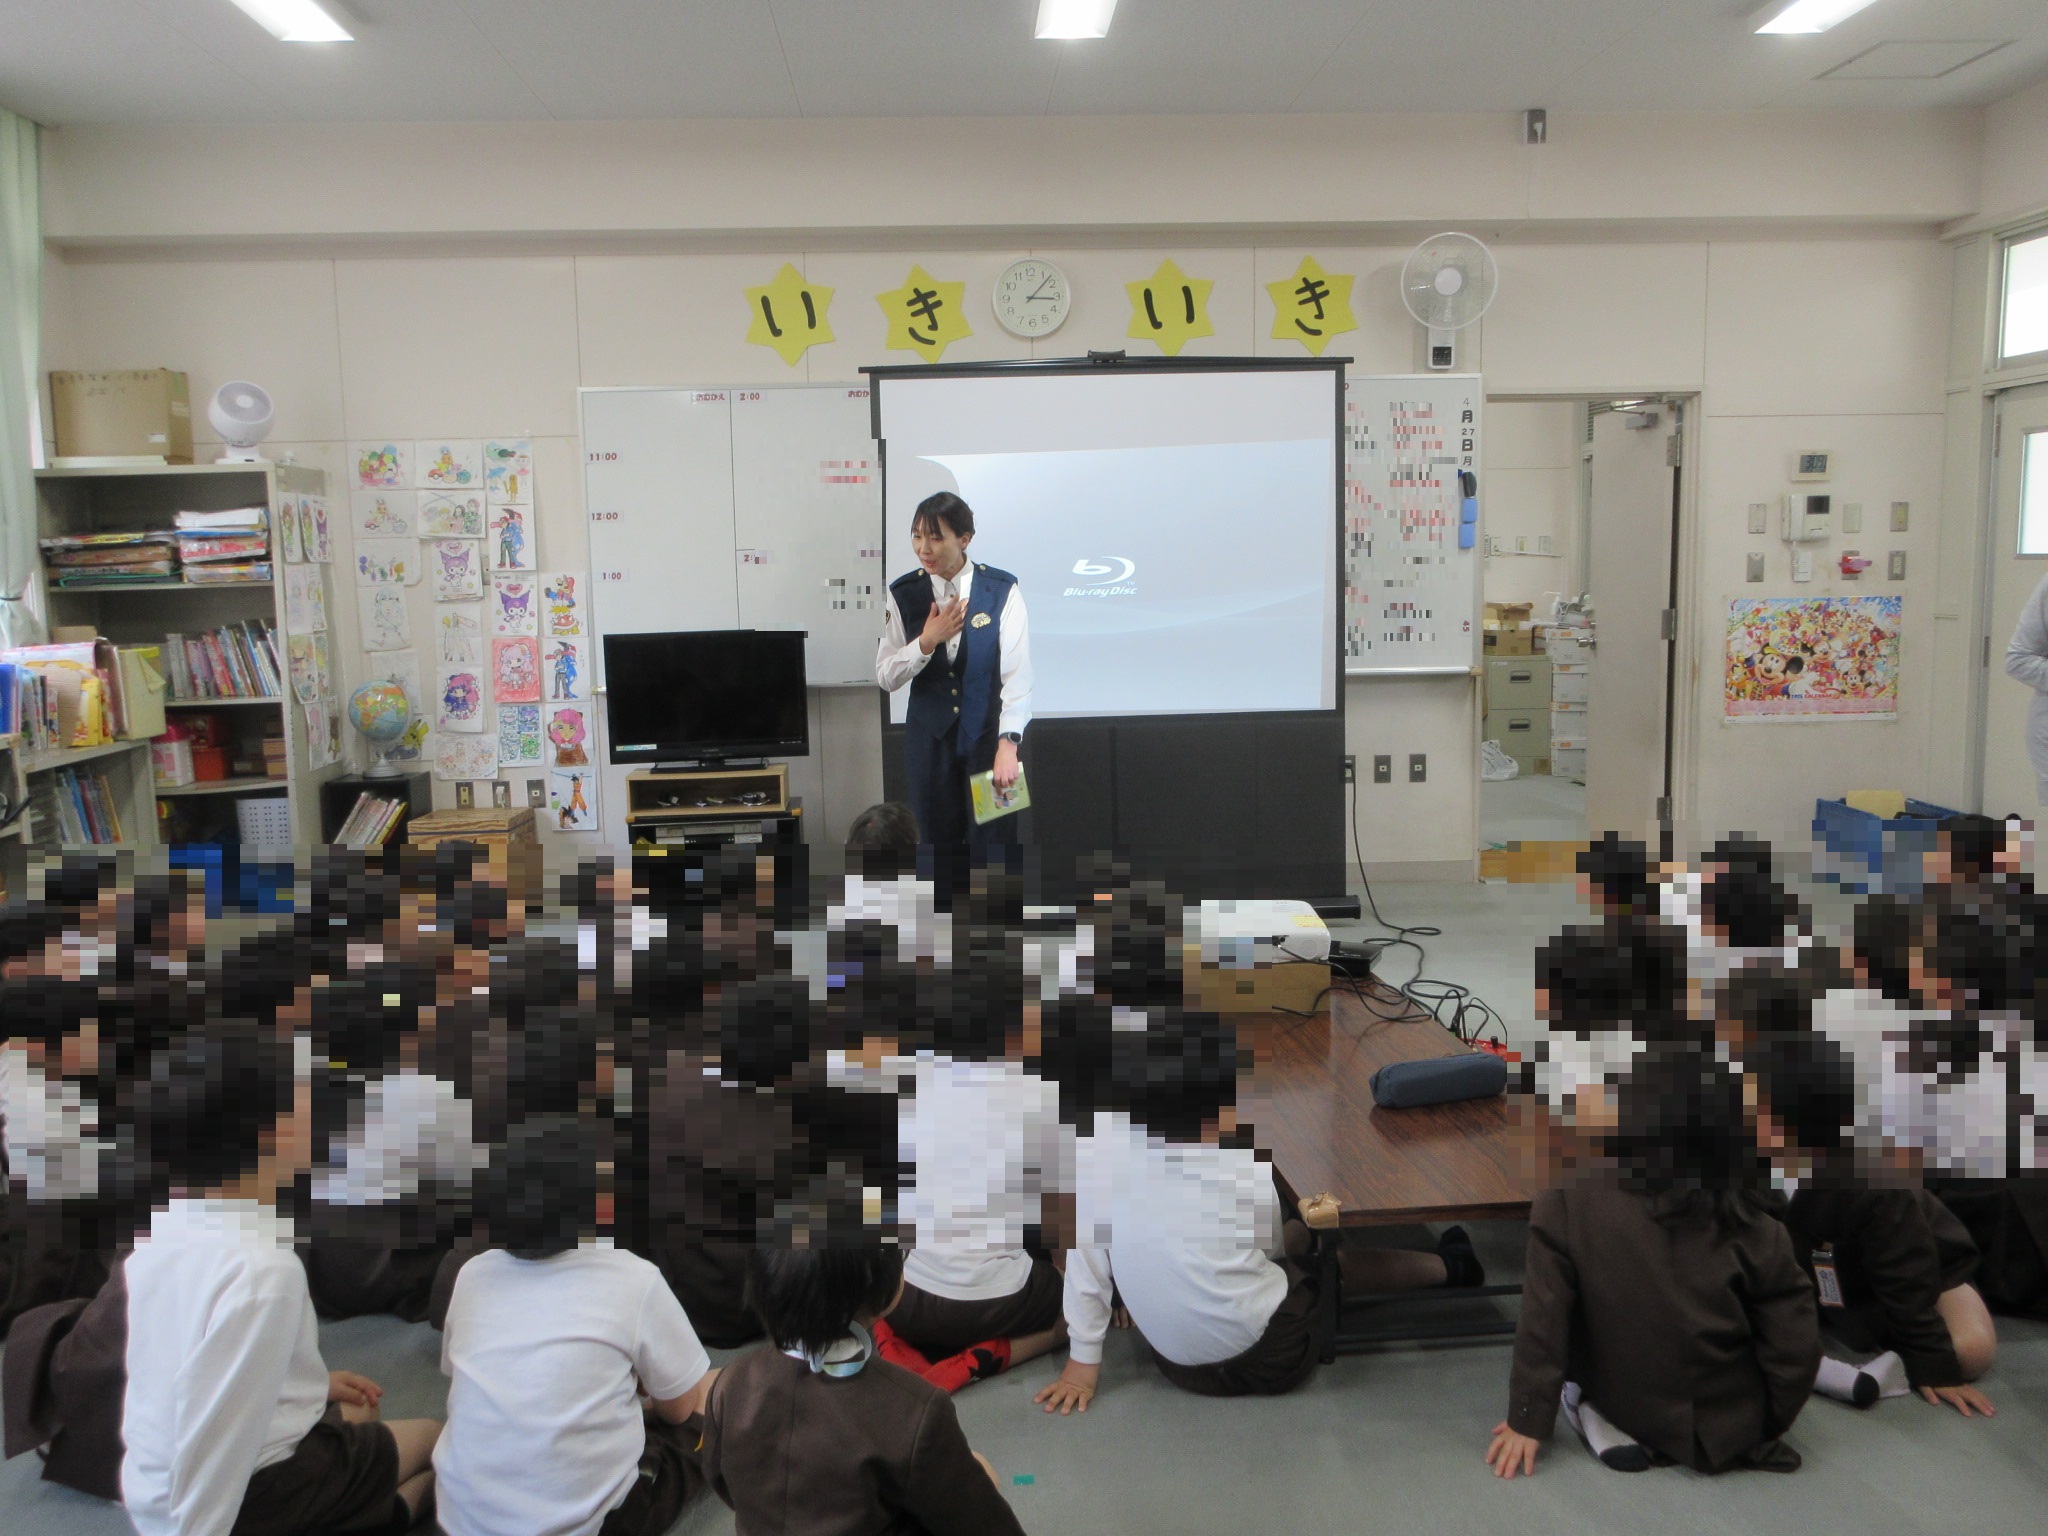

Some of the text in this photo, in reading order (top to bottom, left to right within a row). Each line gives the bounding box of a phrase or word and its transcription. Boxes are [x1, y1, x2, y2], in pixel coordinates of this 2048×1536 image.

[1025, 268, 1035, 276] 12
[1041, 271, 1045, 279] 1
[1014, 272, 1022, 281] 11
[1006, 282, 1016, 291] 10
[1048, 279, 1056, 288] 2
[1002, 295, 1010, 303] 9
[1053, 292, 1060, 301] 3
[1007, 307, 1014, 315] 8
[1050, 305, 1057, 313] 4
[1029, 319, 1036, 327] 6
[1041, 315, 1048, 323] 5
[740, 392, 760, 401] 2:00
[589, 452, 617, 461] 11:00
[591, 512, 619, 521] 12:00
[602, 572, 622, 580] 1:00
[1109, 586, 1138, 595] Disc
